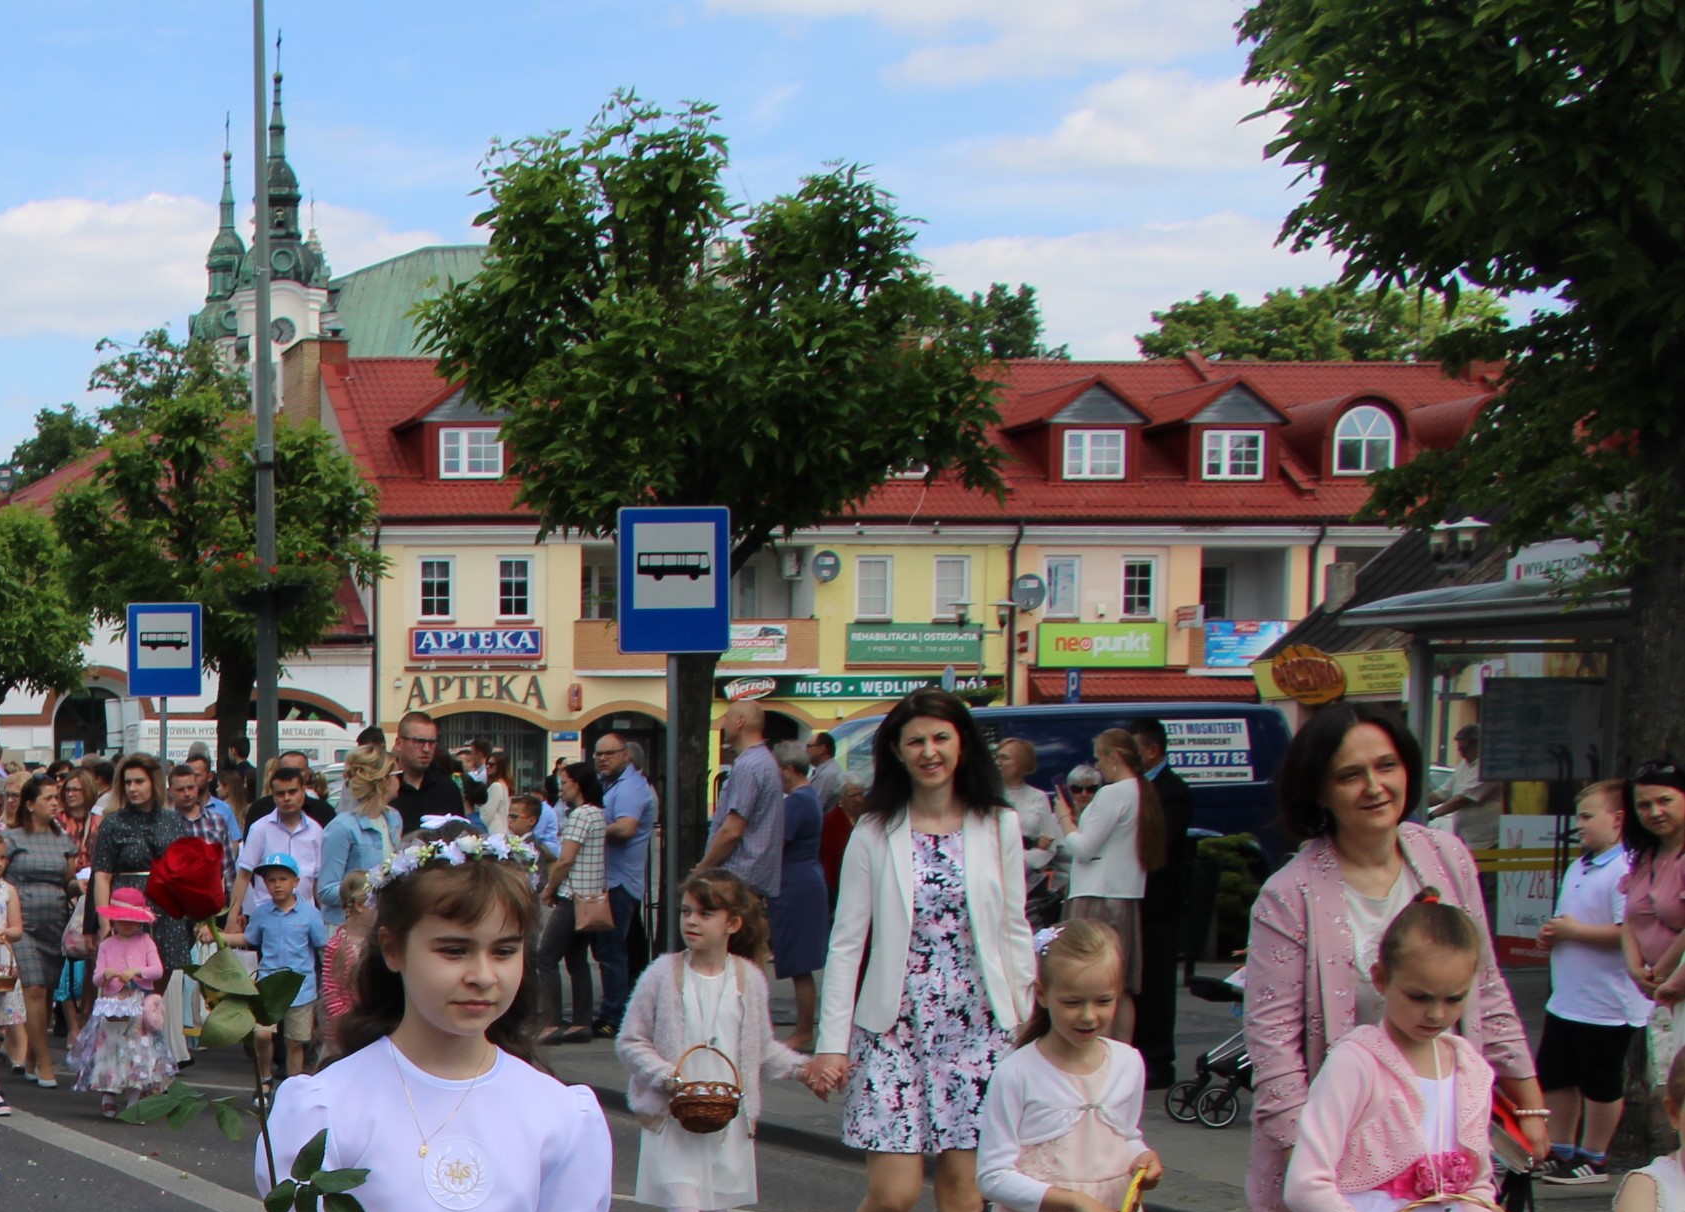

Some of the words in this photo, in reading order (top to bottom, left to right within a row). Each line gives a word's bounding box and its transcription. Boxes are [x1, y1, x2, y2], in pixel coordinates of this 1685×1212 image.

[418, 631, 536, 649] APTEKA
[850, 632, 917, 642] REHABILITACJA
[923, 632, 978, 641] OSTEOPATIA
[1055, 631, 1150, 657] neopunkt
[724, 679, 776, 700] Wierzejki
[795, 681, 842, 697] MIĘSO
[860, 681, 929, 697] WĘDLINY
[1068, 672, 1078, 698] P
[404, 675, 548, 712] APTEKA
[147, 727, 197, 735] HUTOWNIA
[282, 727, 325, 736] METALOWE
[1185, 722, 1242, 734] MOSKITIERY
[1187, 737, 1231, 746] PRODUCENT
[1168, 753, 1183, 765] 81
[1185, 752, 1209, 765] 723
[1212, 752, 1228, 765] 77
[1231, 751, 1248, 764] 82
